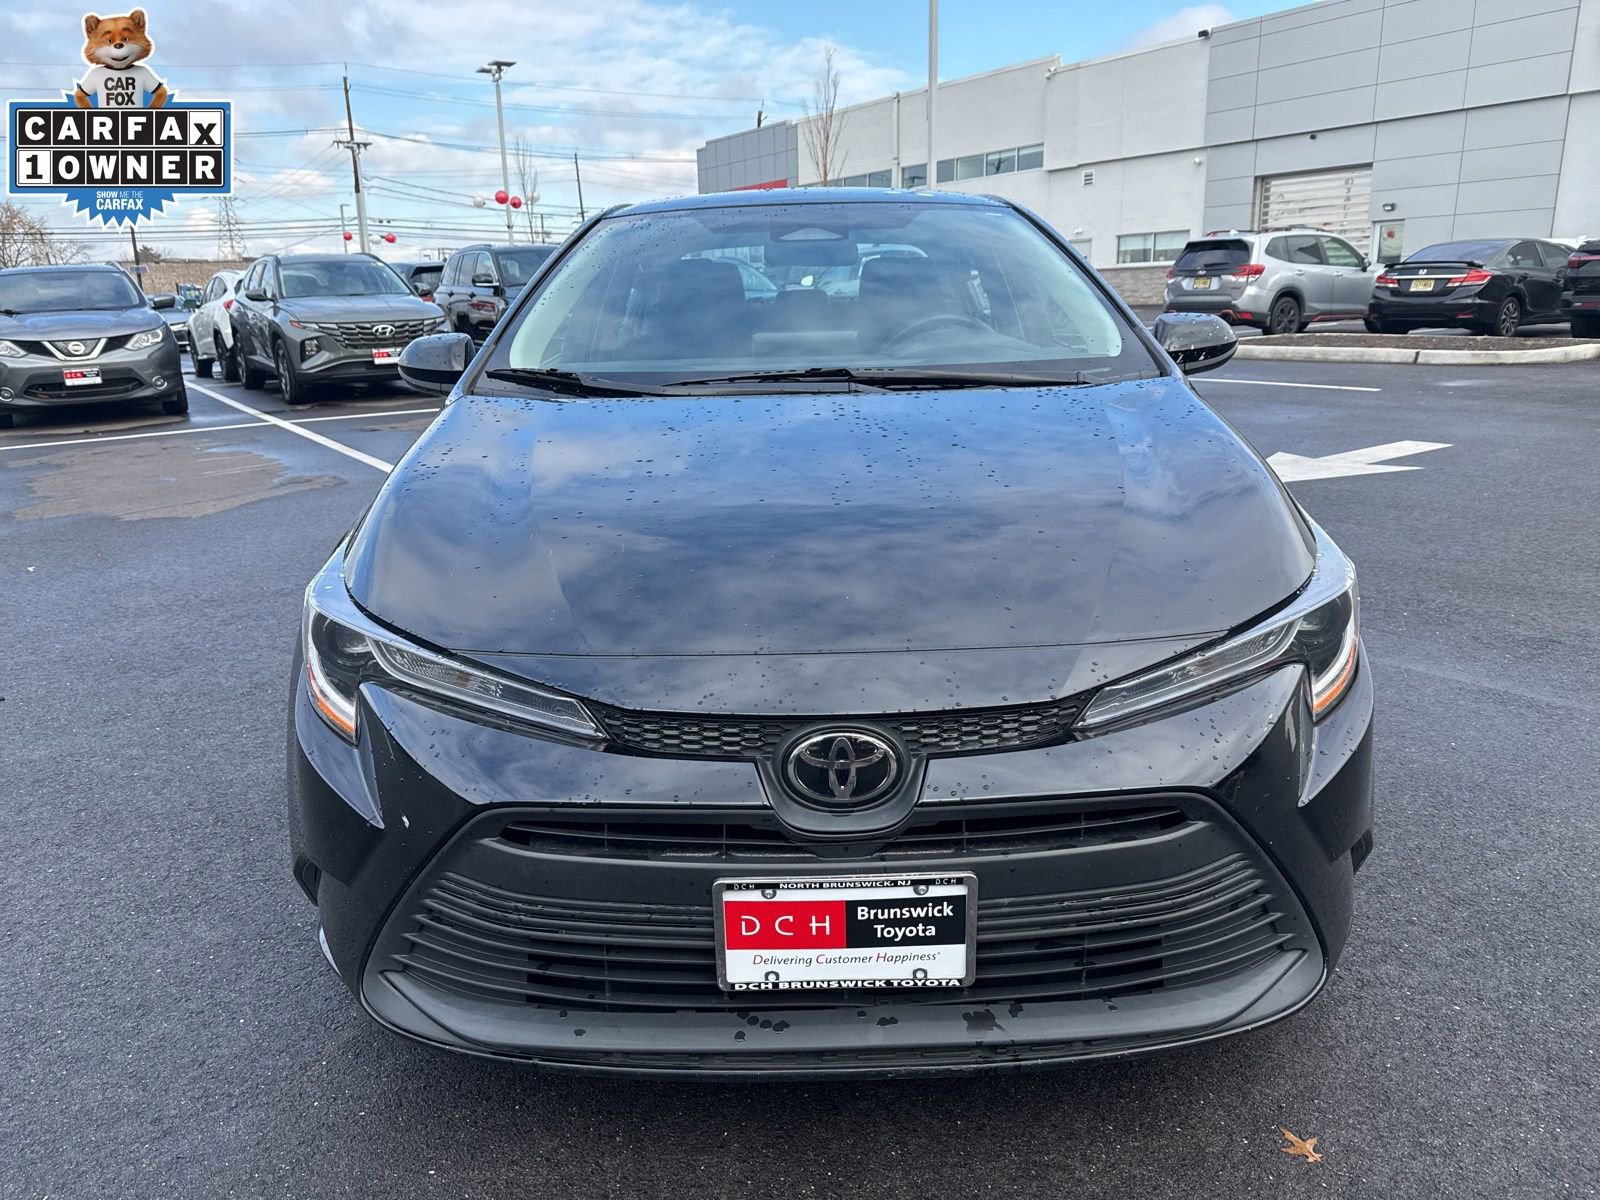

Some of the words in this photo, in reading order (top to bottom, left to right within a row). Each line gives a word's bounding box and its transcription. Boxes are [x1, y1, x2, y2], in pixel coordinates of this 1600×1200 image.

[857, 902, 954, 920] Brunswick
[873, 923, 936, 941] Toyota
[753, 954, 813, 967] Delivering
[815, 954, 873, 964] Customer
[734, 982, 773, 990] DCH
[779, 980, 887, 989] BRUNSWICK
[890, 979, 961, 987] TOYOTA
